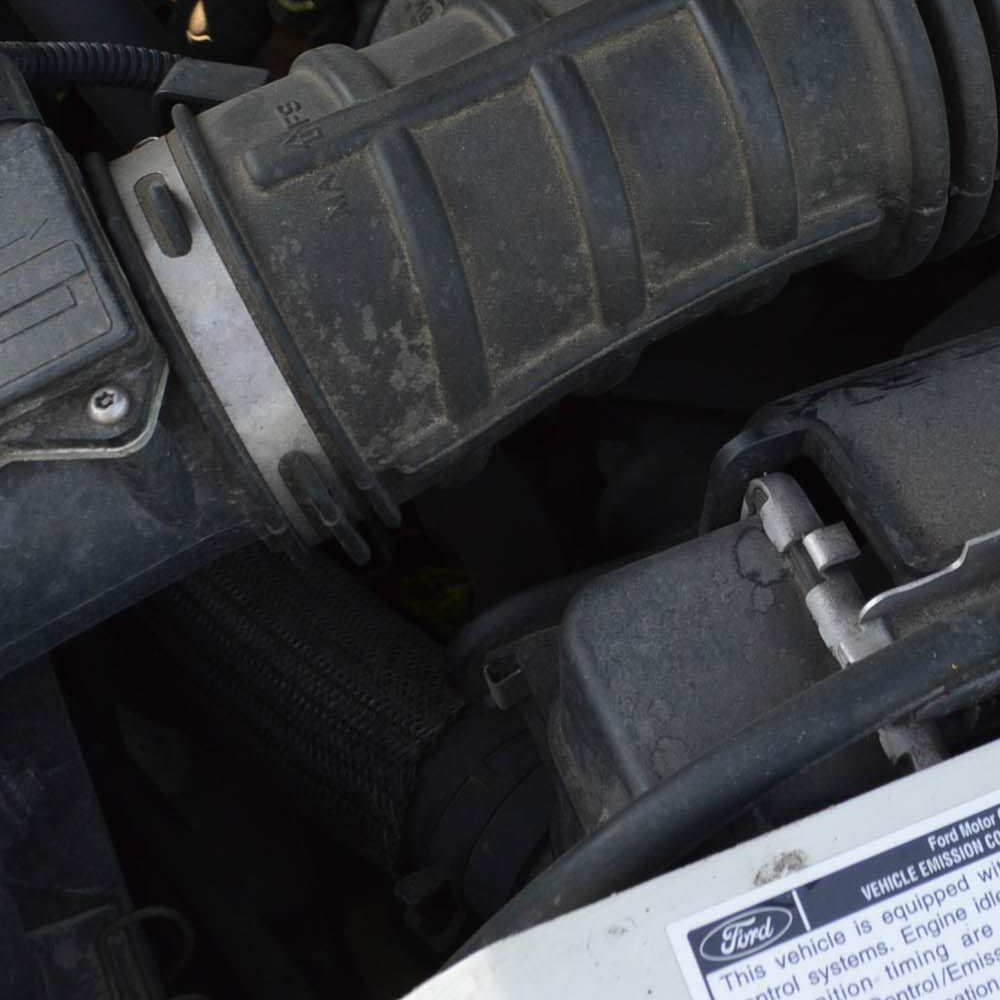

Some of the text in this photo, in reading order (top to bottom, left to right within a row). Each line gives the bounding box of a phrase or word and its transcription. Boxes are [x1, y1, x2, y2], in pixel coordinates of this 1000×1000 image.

[927, 827, 959, 851] Ford
[958, 814, 996, 838] Motor
[860, 865, 918, 901] VEHICLE
[918, 838, 984, 877] EMISSION
[719, 964, 767, 991] This
[775, 931, 846, 969] vehicle
[853, 920, 873, 937] is
[881, 874, 970, 925] equipped
[720, 917, 774, 955] Ford
[807, 941, 894, 985] systems.
[900, 907, 968, 945] Engine
[884, 943, 950, 981] timing
[961, 924, 994, 948] are
